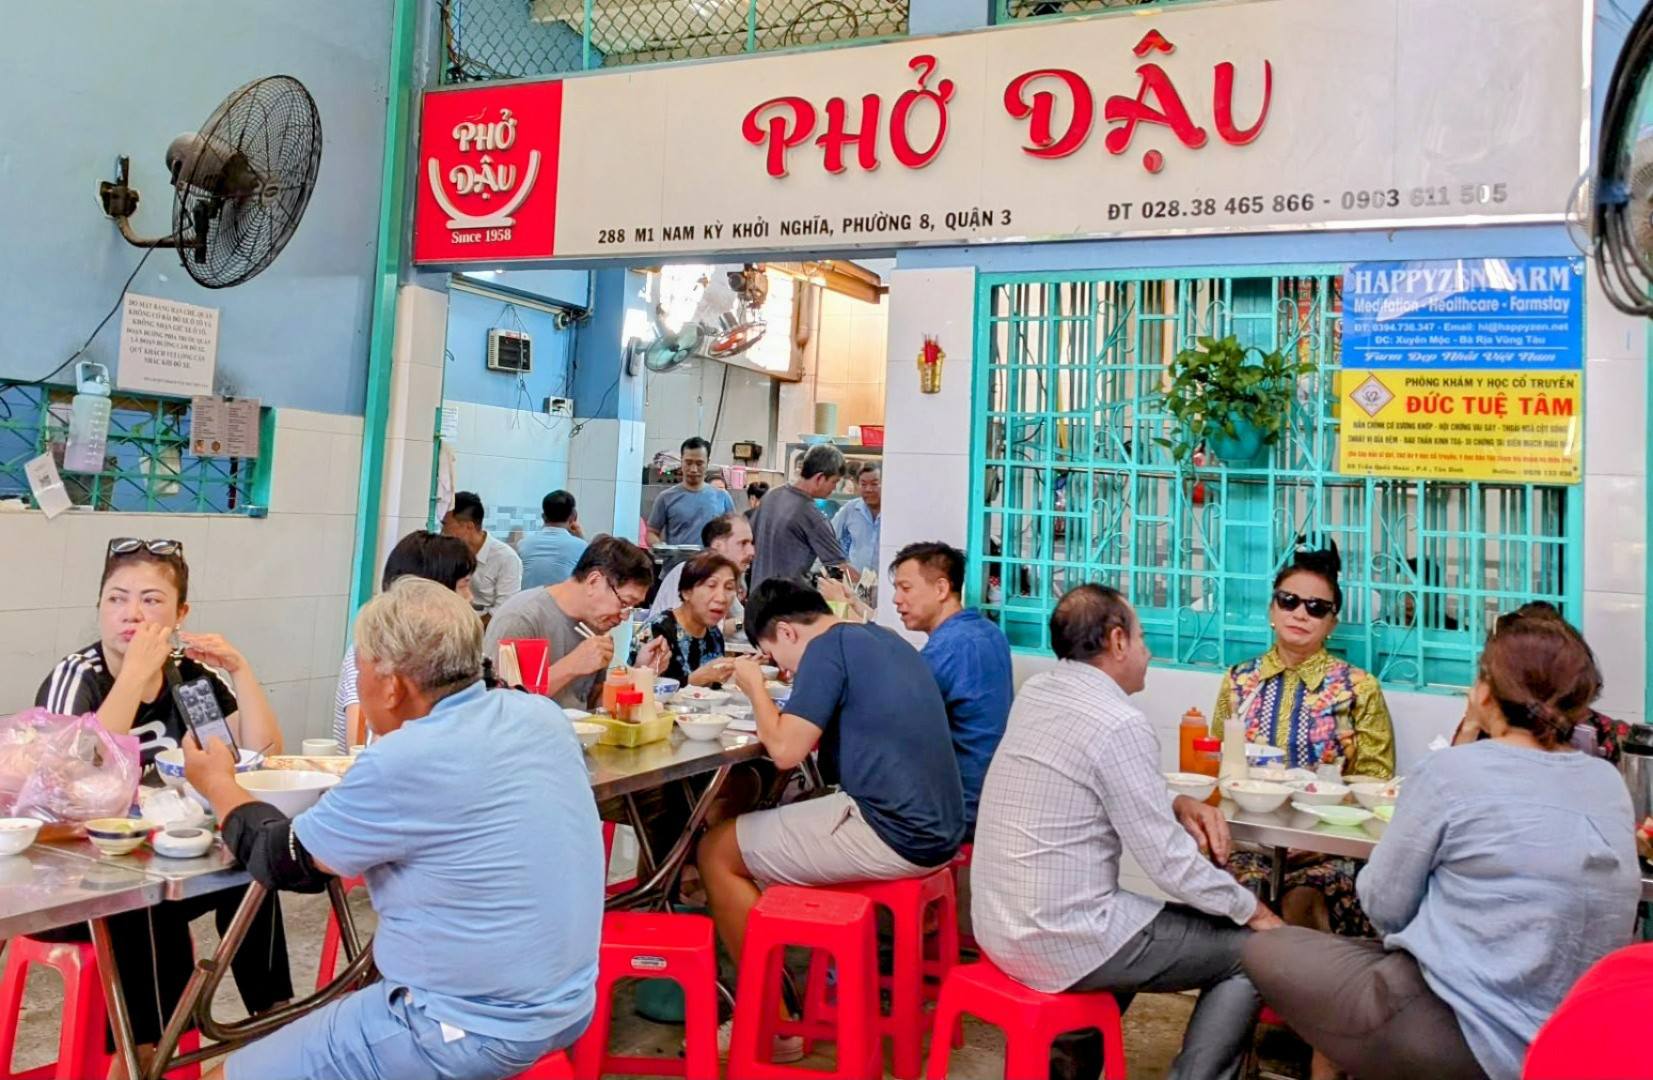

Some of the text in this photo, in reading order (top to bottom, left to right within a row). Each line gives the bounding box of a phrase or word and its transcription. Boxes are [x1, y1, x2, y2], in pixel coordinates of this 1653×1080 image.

[741, 29, 1273, 178] PHỞ DẬU
[452, 108, 518, 152] PHỞ
[449, 154, 517, 200] DẬU
[1108, 203, 1133, 220] ĐT
[1142, 198, 1216, 219] 028.38
[1224, 196, 1264, 215] 465
[1272, 193, 1314, 213] 866
[1341, 189, 1400, 210] 0903
[1460, 182, 1507, 205] 505
[451, 228, 512, 244] Since 1958
[598, 207, 1012, 244] 288 M1 NAM KỲ KHỞI NGHĨA, PHƯỜNG 8, QUẬN 3
[1496, 266, 1571, 292] ARM
[1428, 296, 1499, 312] Healthcare
[1510, 295, 1570, 314] Farmstay
[1442, 376, 1473, 387] KHÁM
[1406, 391, 1573, 419] ĐỨC TUỆ TÂM
